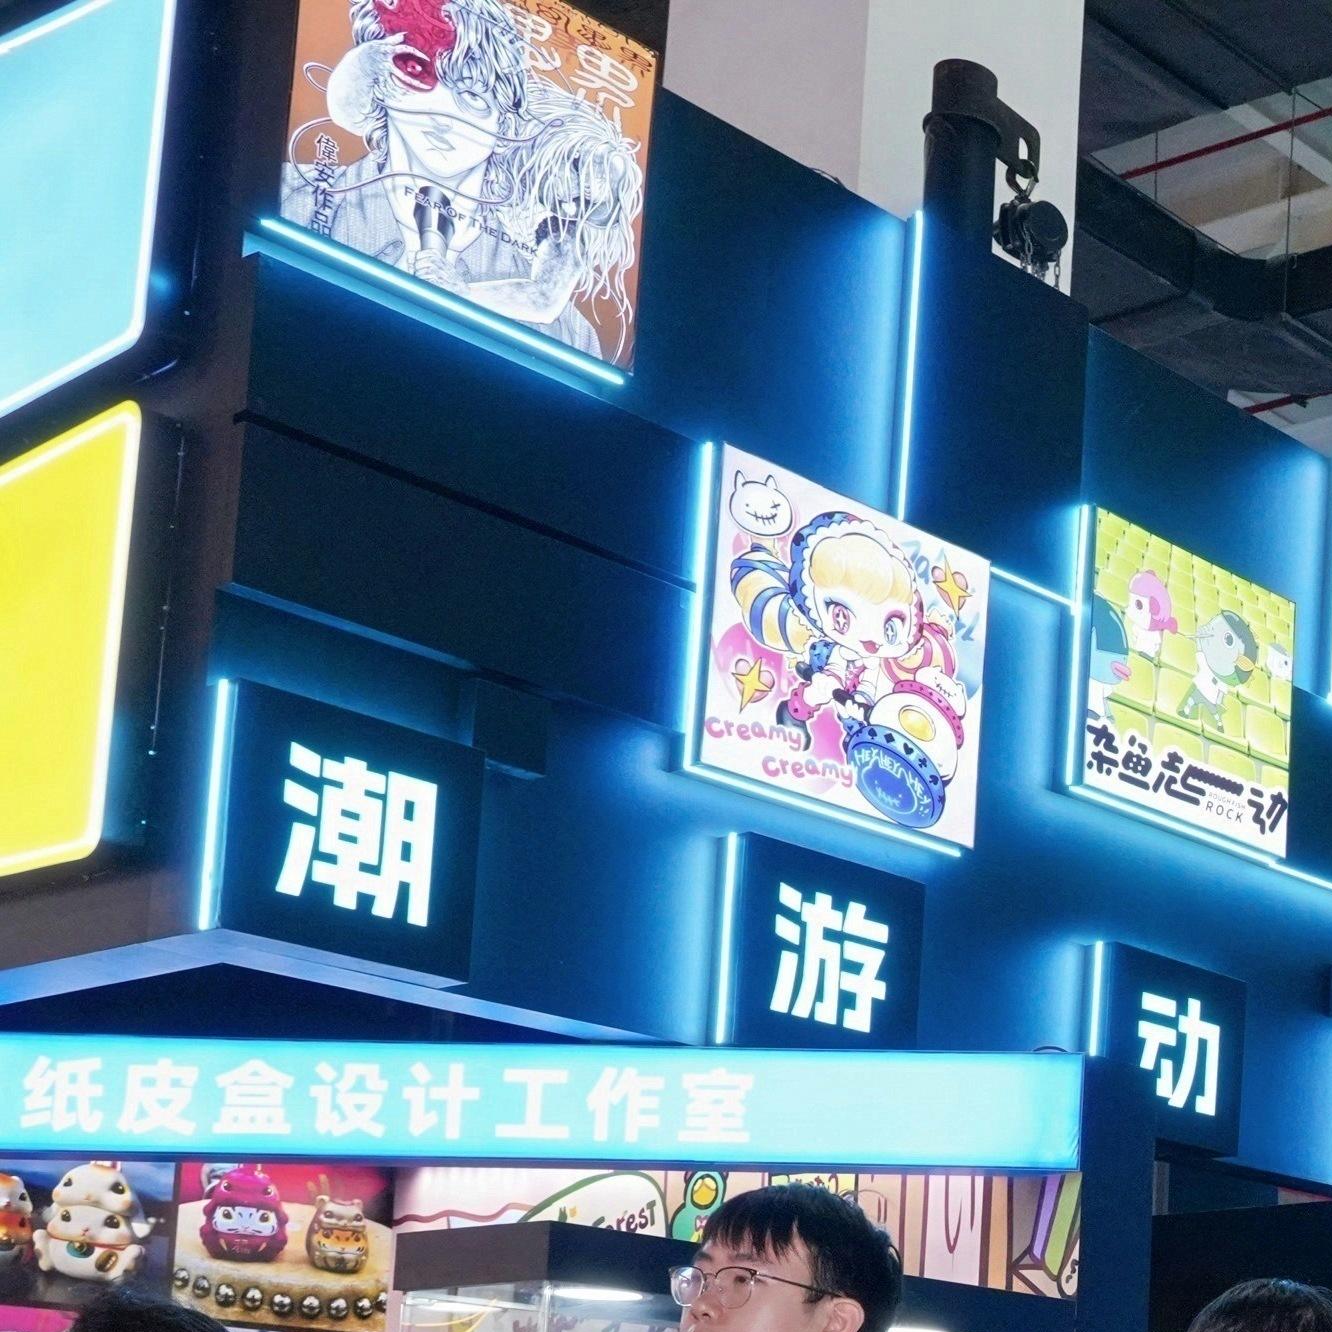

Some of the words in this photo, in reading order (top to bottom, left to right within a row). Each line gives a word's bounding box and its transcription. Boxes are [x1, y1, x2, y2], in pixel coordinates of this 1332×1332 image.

[404, 186, 444, 215] FEAR
[449, 205, 467, 222] OF
[471, 217, 500, 239] THE
[501, 230, 538, 255] DARK
[705, 716, 802, 752] Creamy
[762, 755, 854, 787] Creamy
[1205, 800, 1245, 824] ROCK
[274, 740, 438, 928] 潮
[769, 880, 890, 1034] 游
[1138, 990, 1224, 1118] 动
[20, 1055, 757, 1145] 纸皮盒设计工作室
